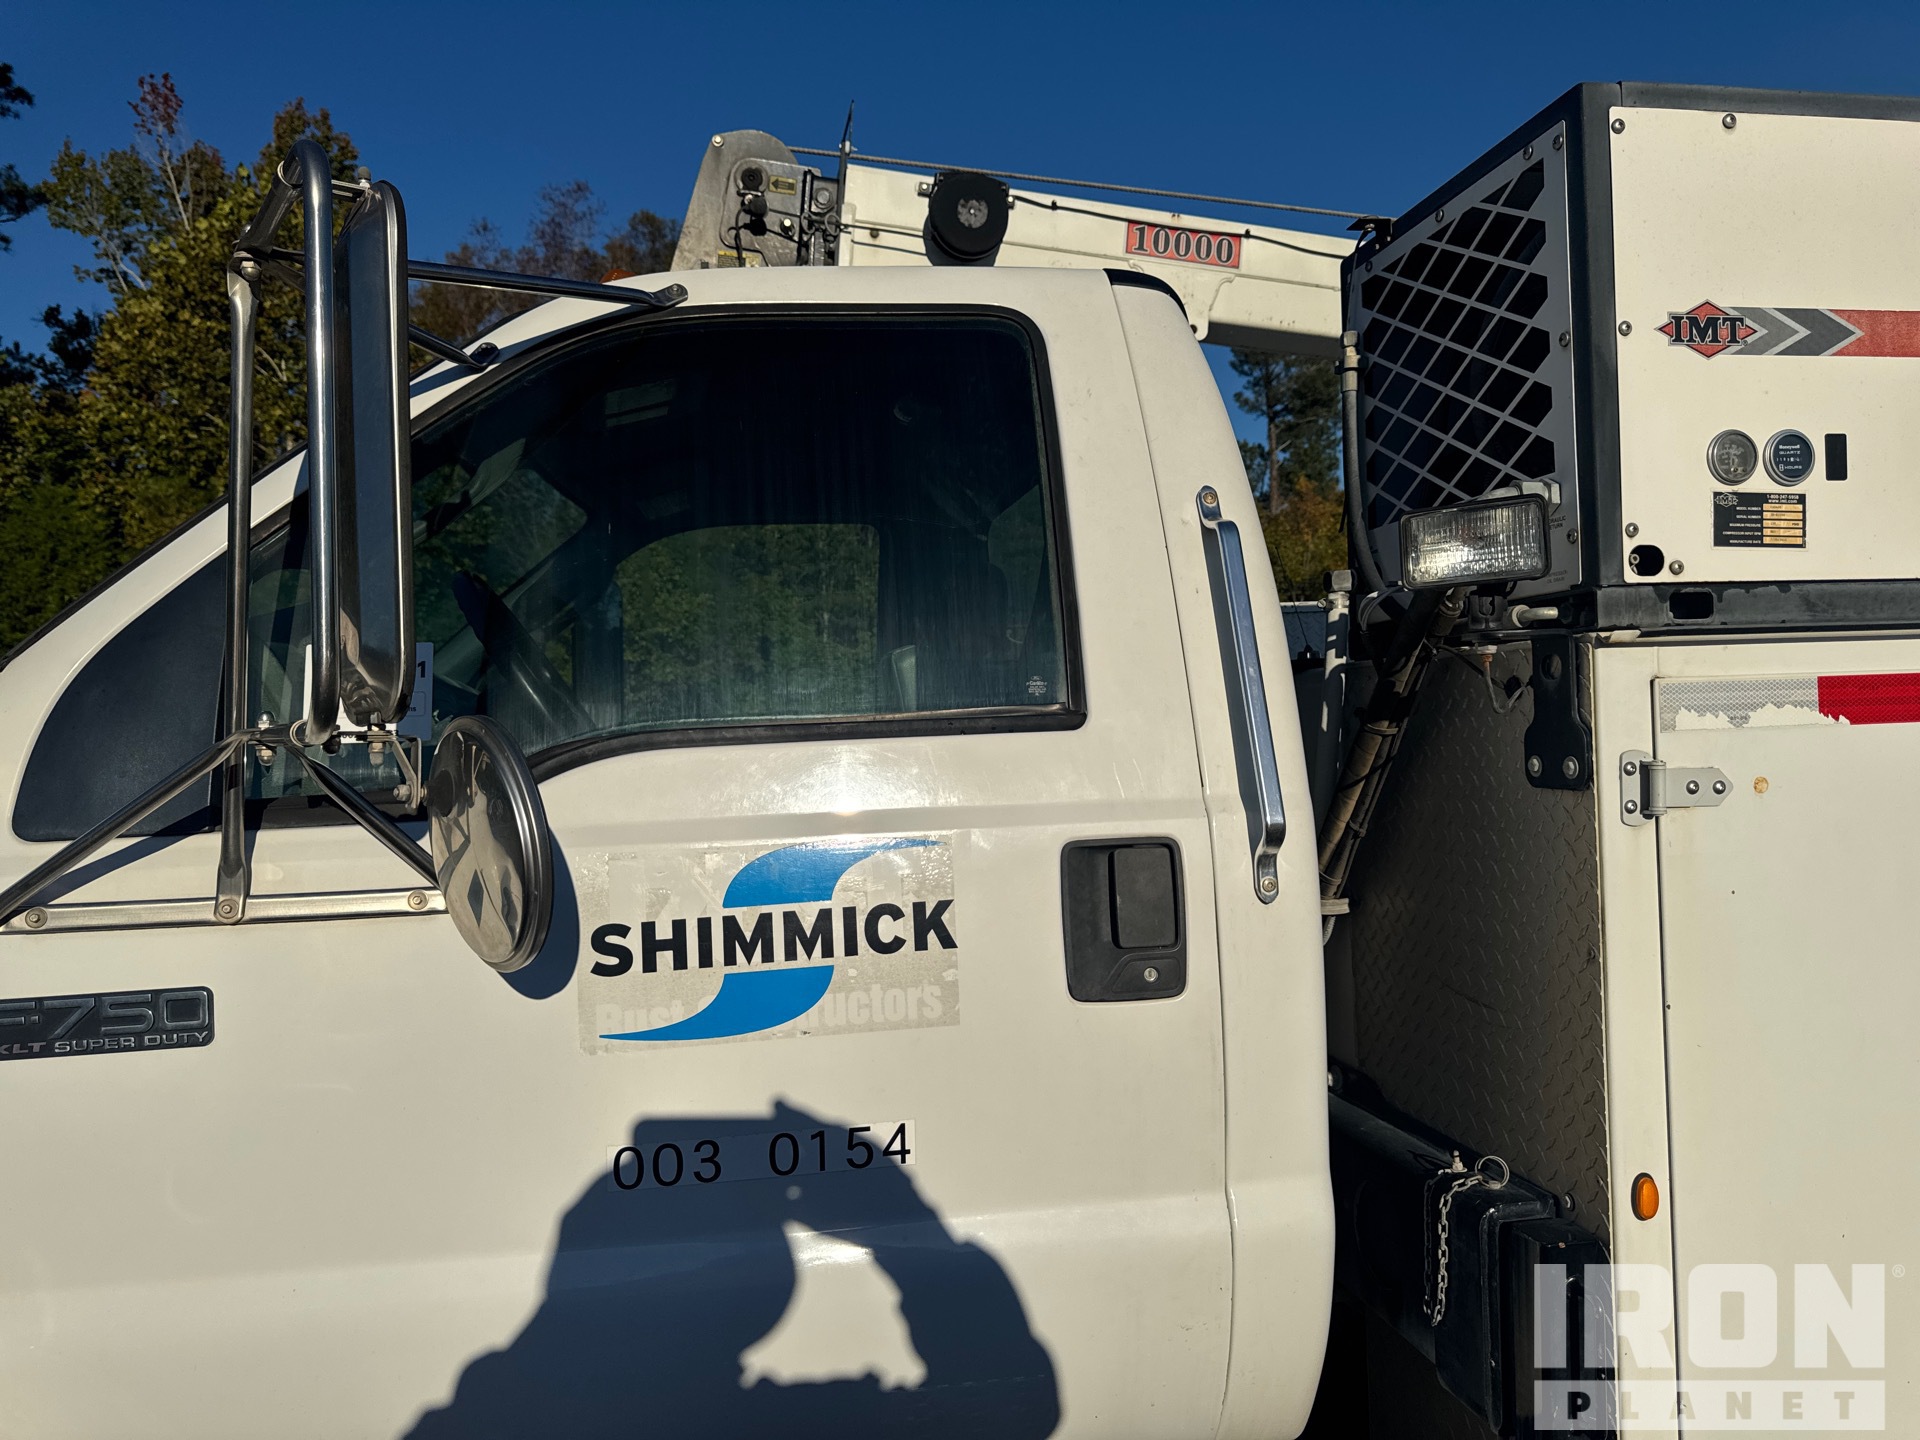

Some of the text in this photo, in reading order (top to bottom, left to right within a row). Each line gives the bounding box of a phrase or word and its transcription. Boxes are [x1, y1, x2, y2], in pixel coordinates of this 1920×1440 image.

[1132, 223, 1234, 265] 10000
[1669, 314, 1746, 346] IMT
[590, 899, 958, 977] SHIMMICK
[54, 1037, 135, 1053] SUPER
[144, 1031, 209, 1046] DUTY
[613, 1122, 911, 1190] 003 0154
